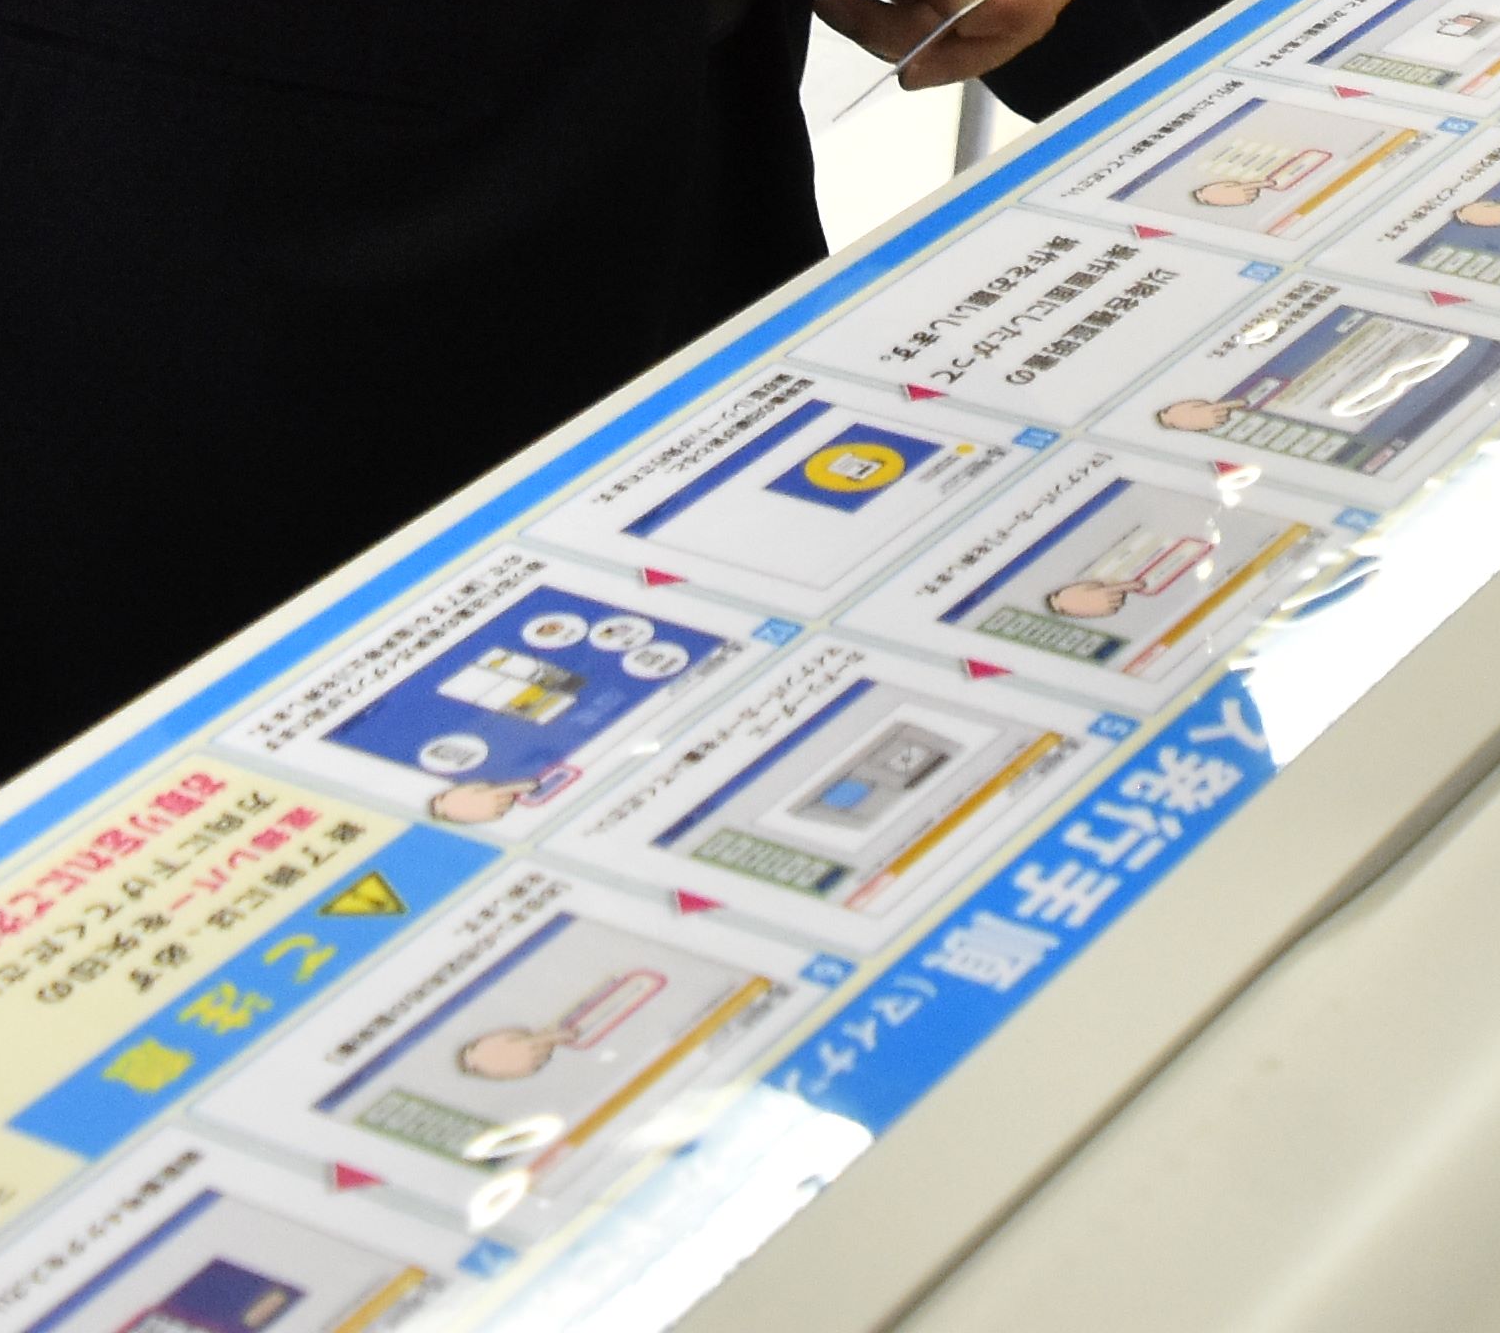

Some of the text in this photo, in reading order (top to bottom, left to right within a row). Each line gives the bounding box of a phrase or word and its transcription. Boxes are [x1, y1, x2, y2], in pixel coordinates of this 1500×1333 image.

[874, 234, 1084, 367] 操作をお願いします。
[924, 242, 1144, 386] 操作画面にしたがって
[996, 266, 1182, 388] 以降各種証明書の
[109, 818, 373, 996] 終了時には、必ず
[89, 928, 351, 1099] ご注意
